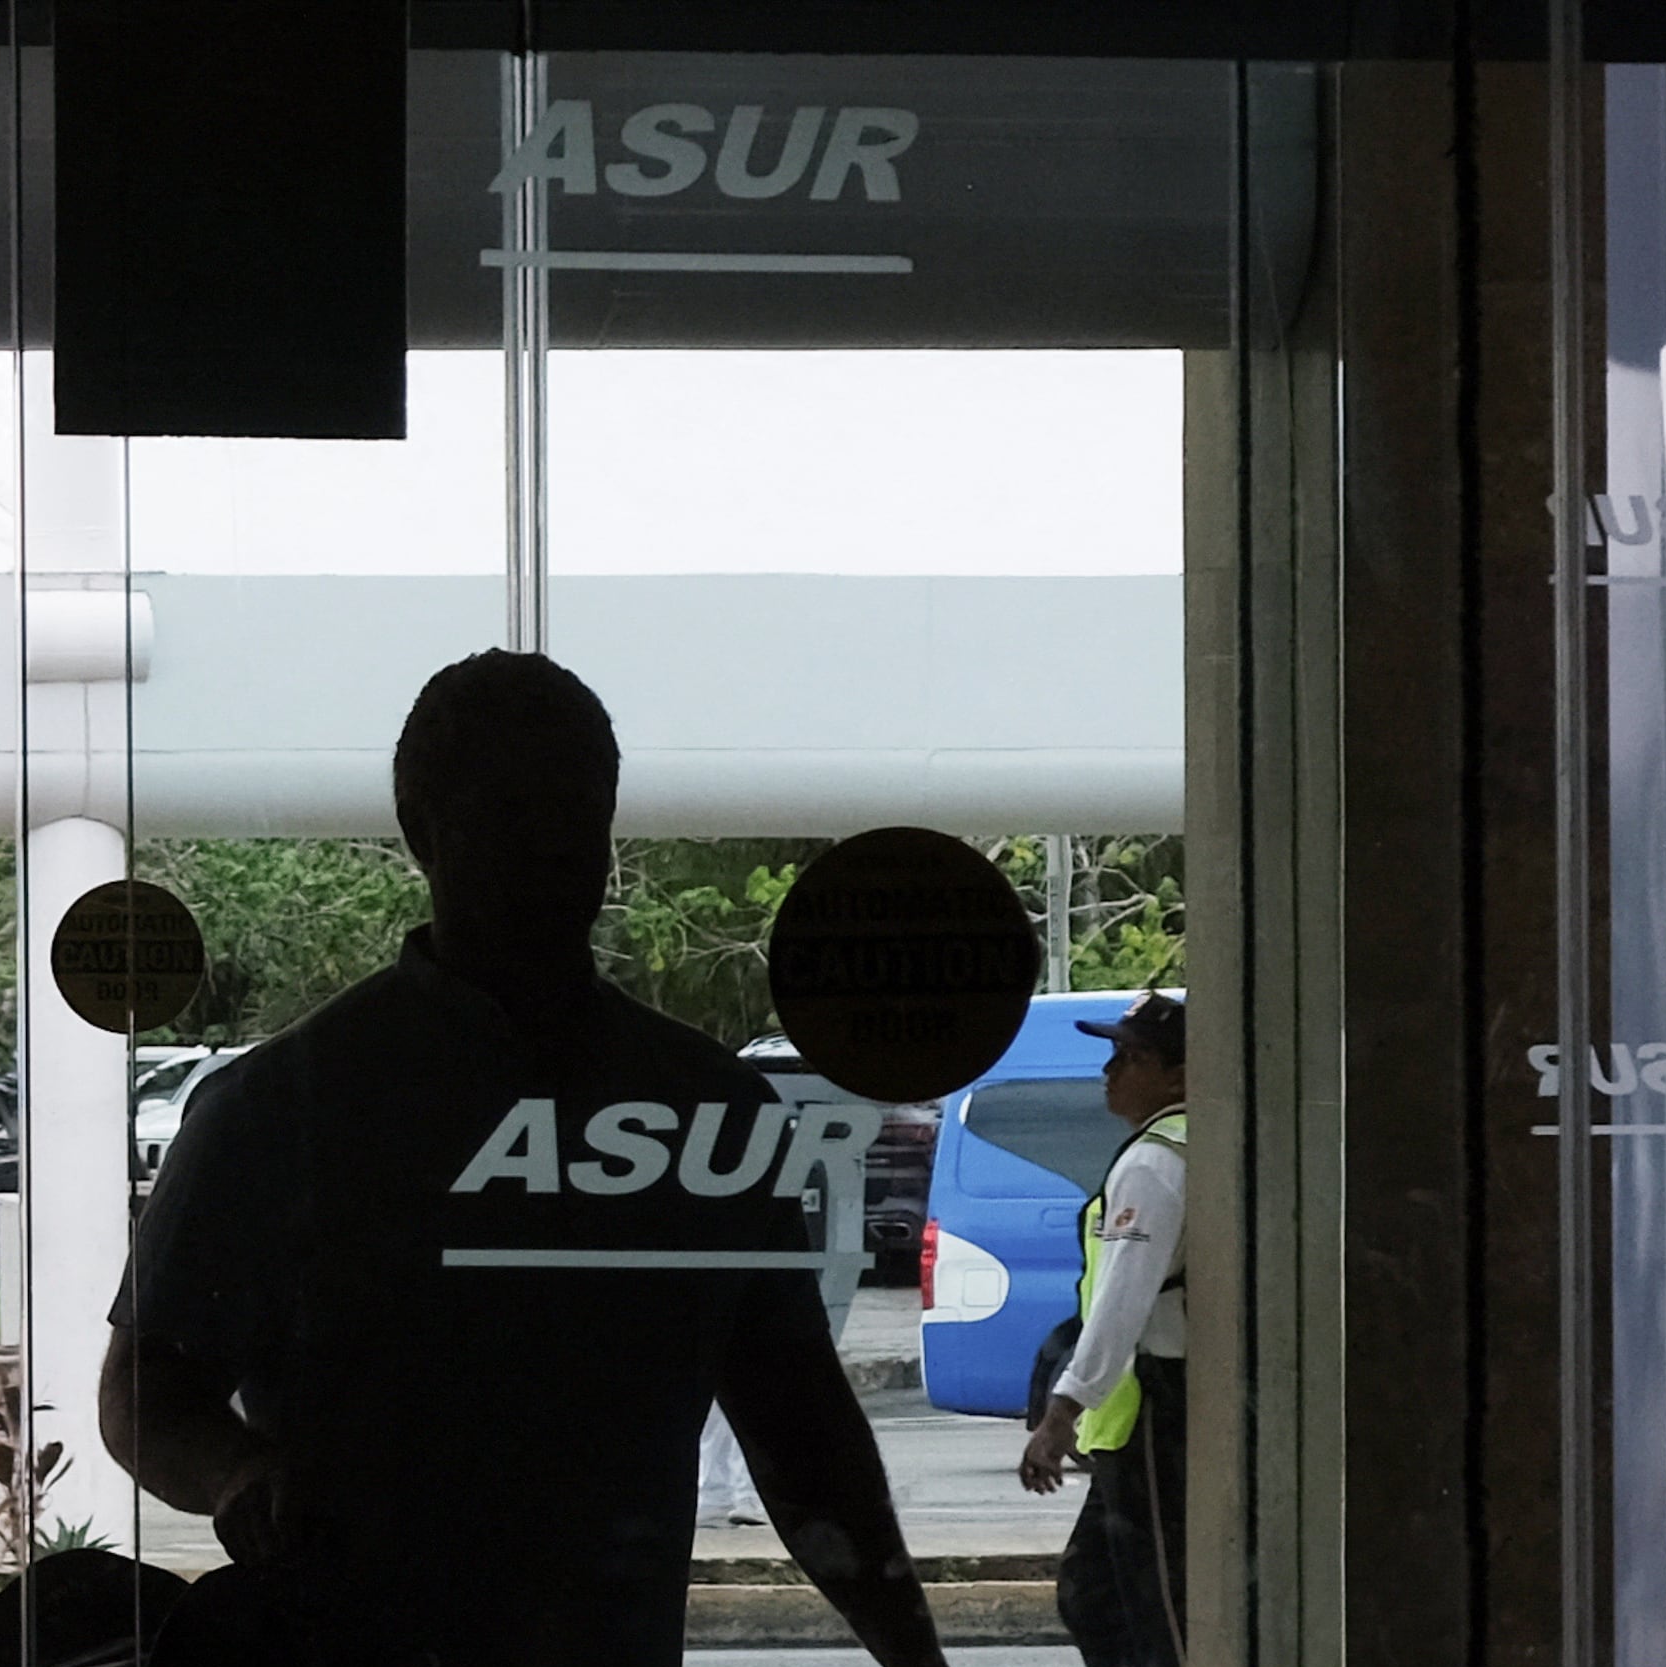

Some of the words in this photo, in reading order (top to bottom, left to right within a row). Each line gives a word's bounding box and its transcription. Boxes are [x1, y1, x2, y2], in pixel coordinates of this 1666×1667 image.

[487, 99, 920, 201] ASUR
[779, 940, 1021, 990] CAUTION
[448, 1097, 883, 1199] ASUR
